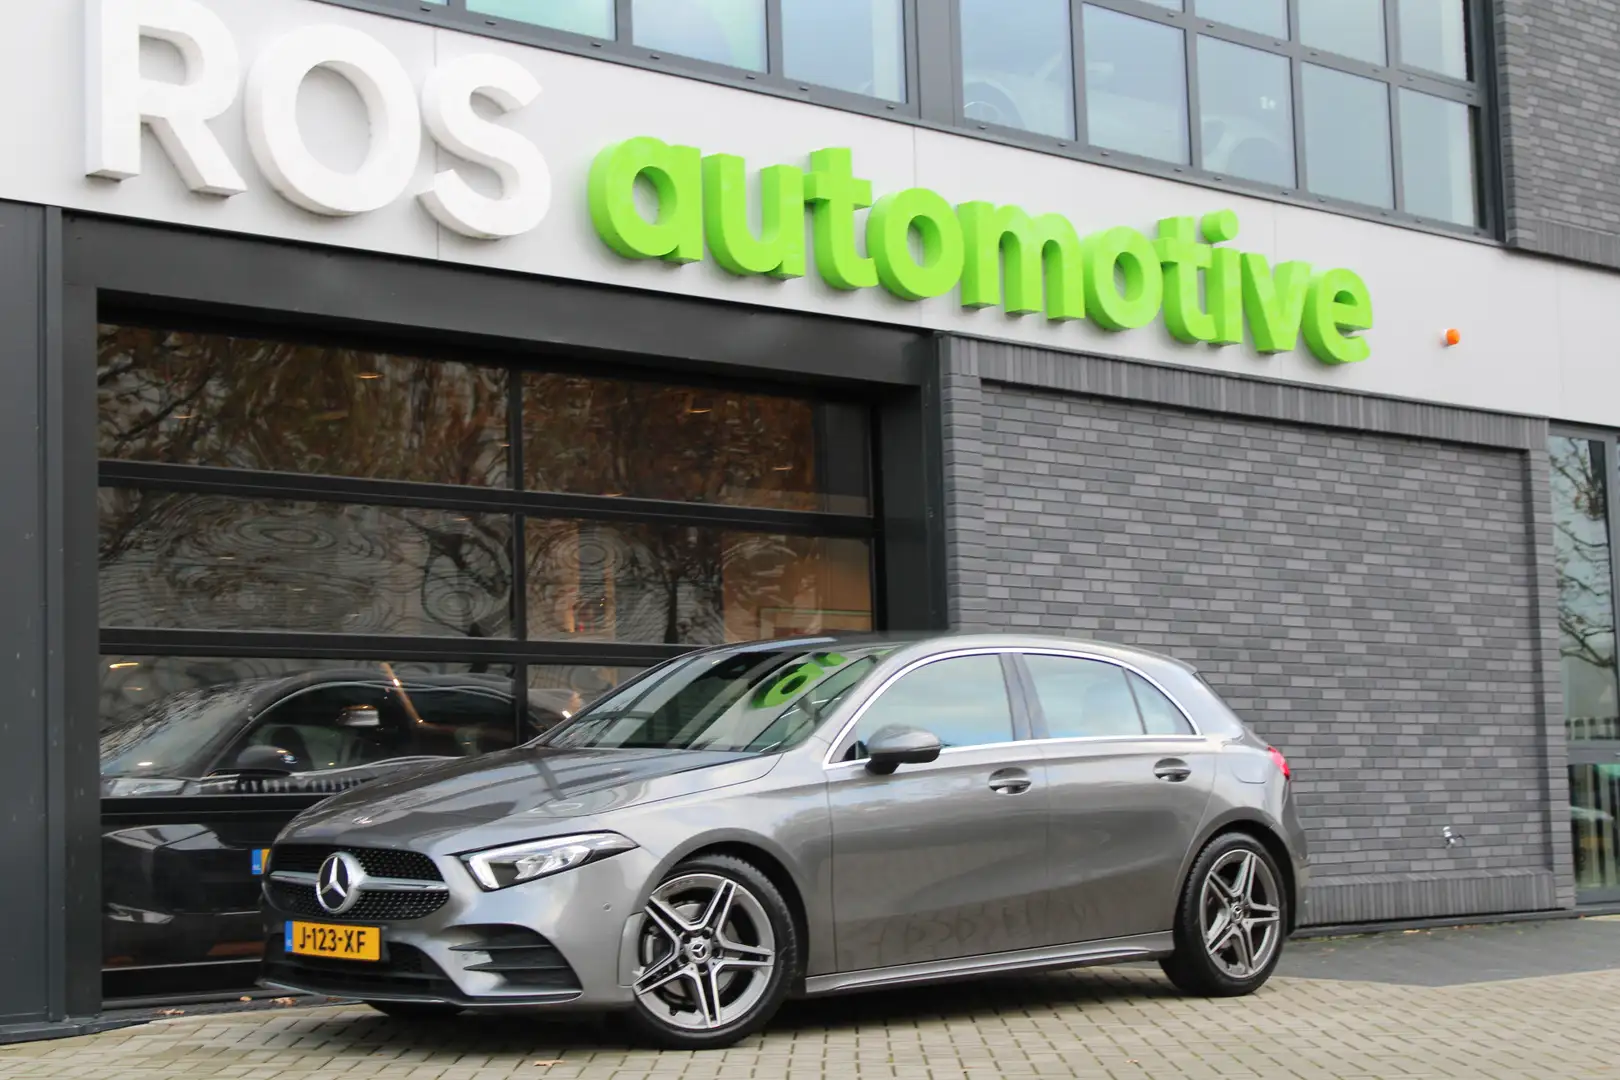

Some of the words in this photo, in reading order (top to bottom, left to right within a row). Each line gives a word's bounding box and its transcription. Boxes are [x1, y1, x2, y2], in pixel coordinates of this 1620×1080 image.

[85, 0, 551, 239] ROS
[588, 136, 1373, 365] automotive
[299, 926, 366, 953] J-123-XF
